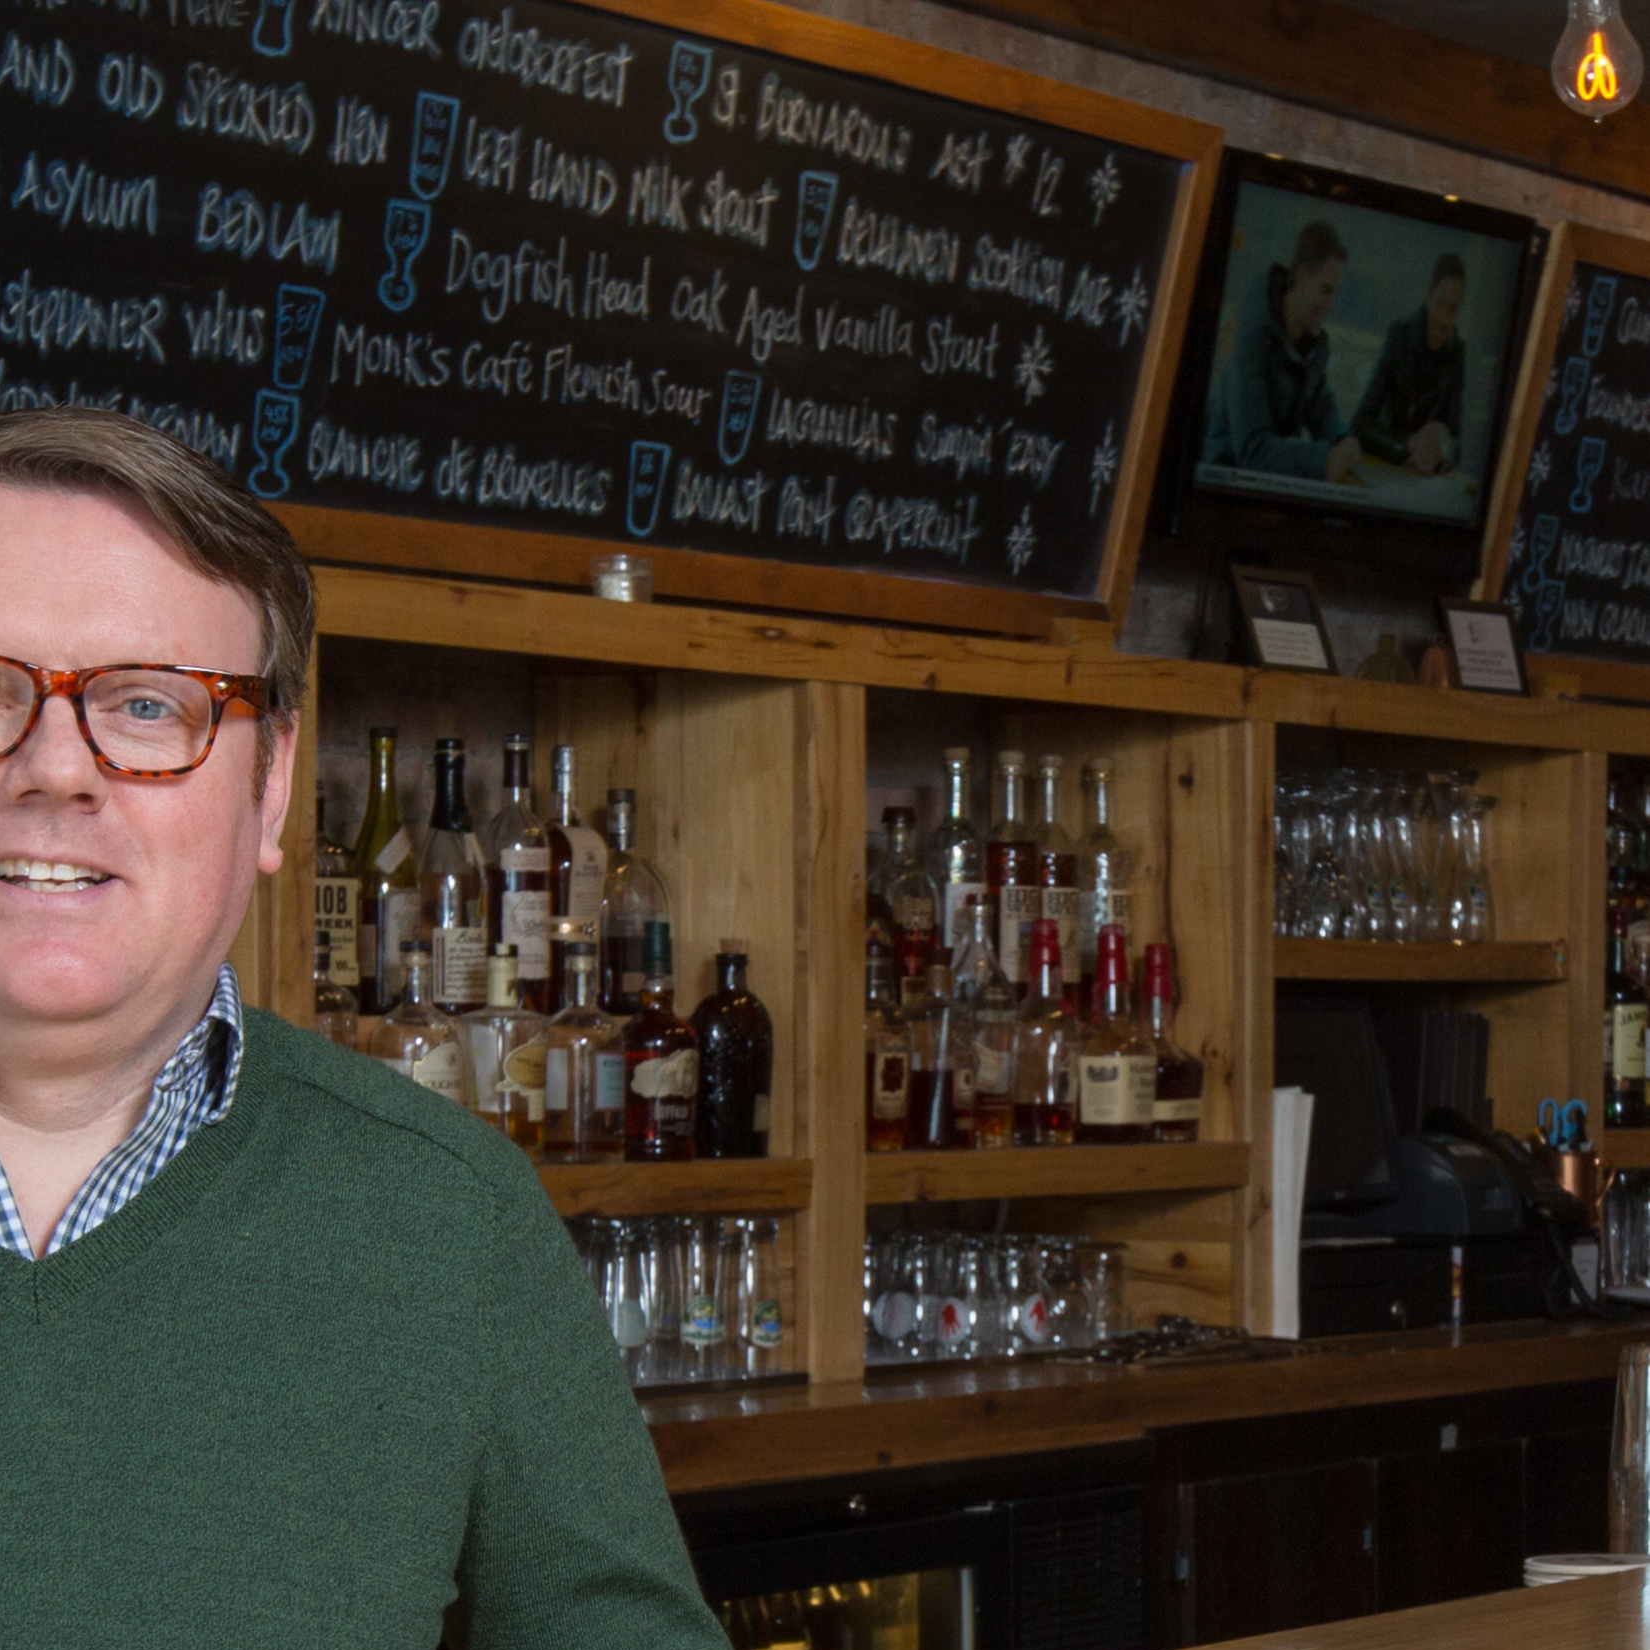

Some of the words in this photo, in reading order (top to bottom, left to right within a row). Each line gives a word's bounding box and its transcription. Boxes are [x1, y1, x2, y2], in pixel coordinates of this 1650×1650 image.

[96, 50, 165, 120] OLD
[528, 138, 618, 217] HAND
[443, 225, 576, 325] Dogfish
[580, 248, 652, 322] Head
[733, 283, 804, 367] Aged
[814, 300, 914, 358] Vanilla
[918, 312, 1000, 380] Stout
[328, 318, 453, 387] Monk's
[459, 338, 536, 398] Café
[540, 342, 641, 412] Flemish
[643, 368, 713, 425] Sour
